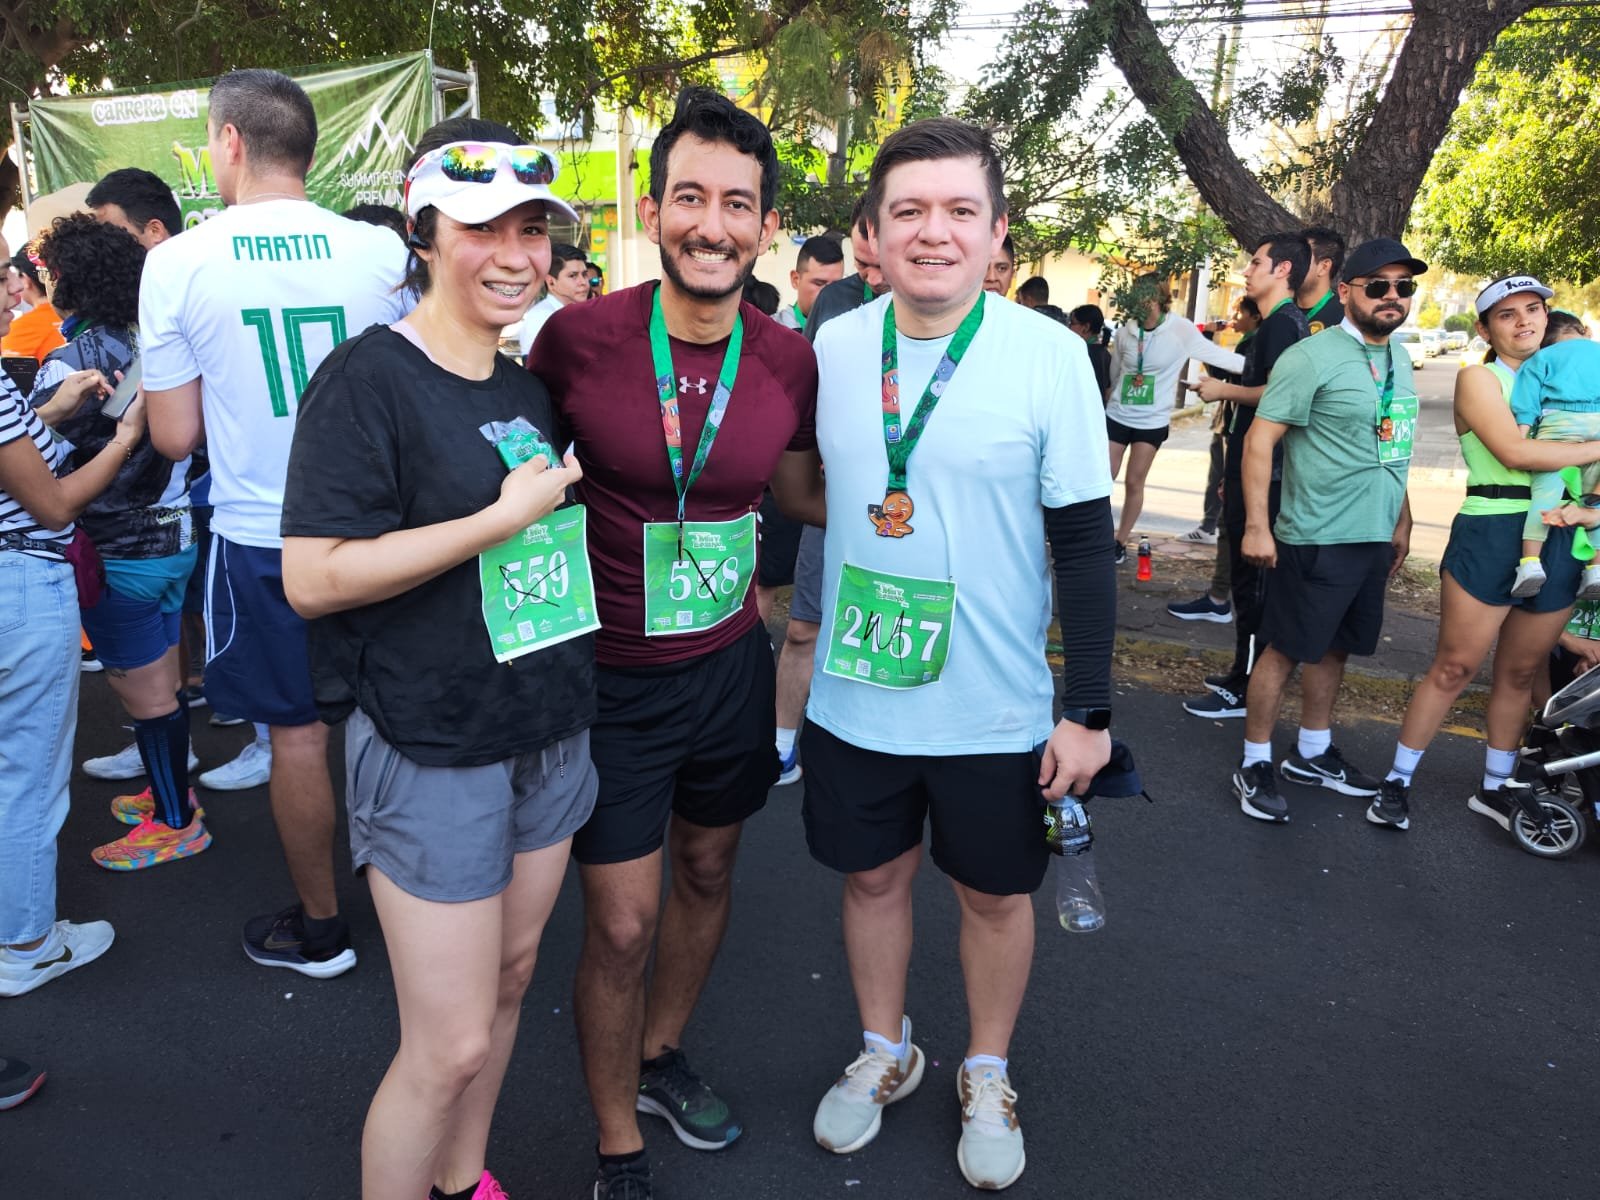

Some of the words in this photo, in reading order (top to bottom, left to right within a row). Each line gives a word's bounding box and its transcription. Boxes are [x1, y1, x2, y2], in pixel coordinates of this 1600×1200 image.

[232, 234, 332, 262] MARTIN
[240, 305, 348, 418] 10
[502, 550, 570, 611] 559
[669, 556, 740, 601] 558
[841, 605, 943, 662] 2157
